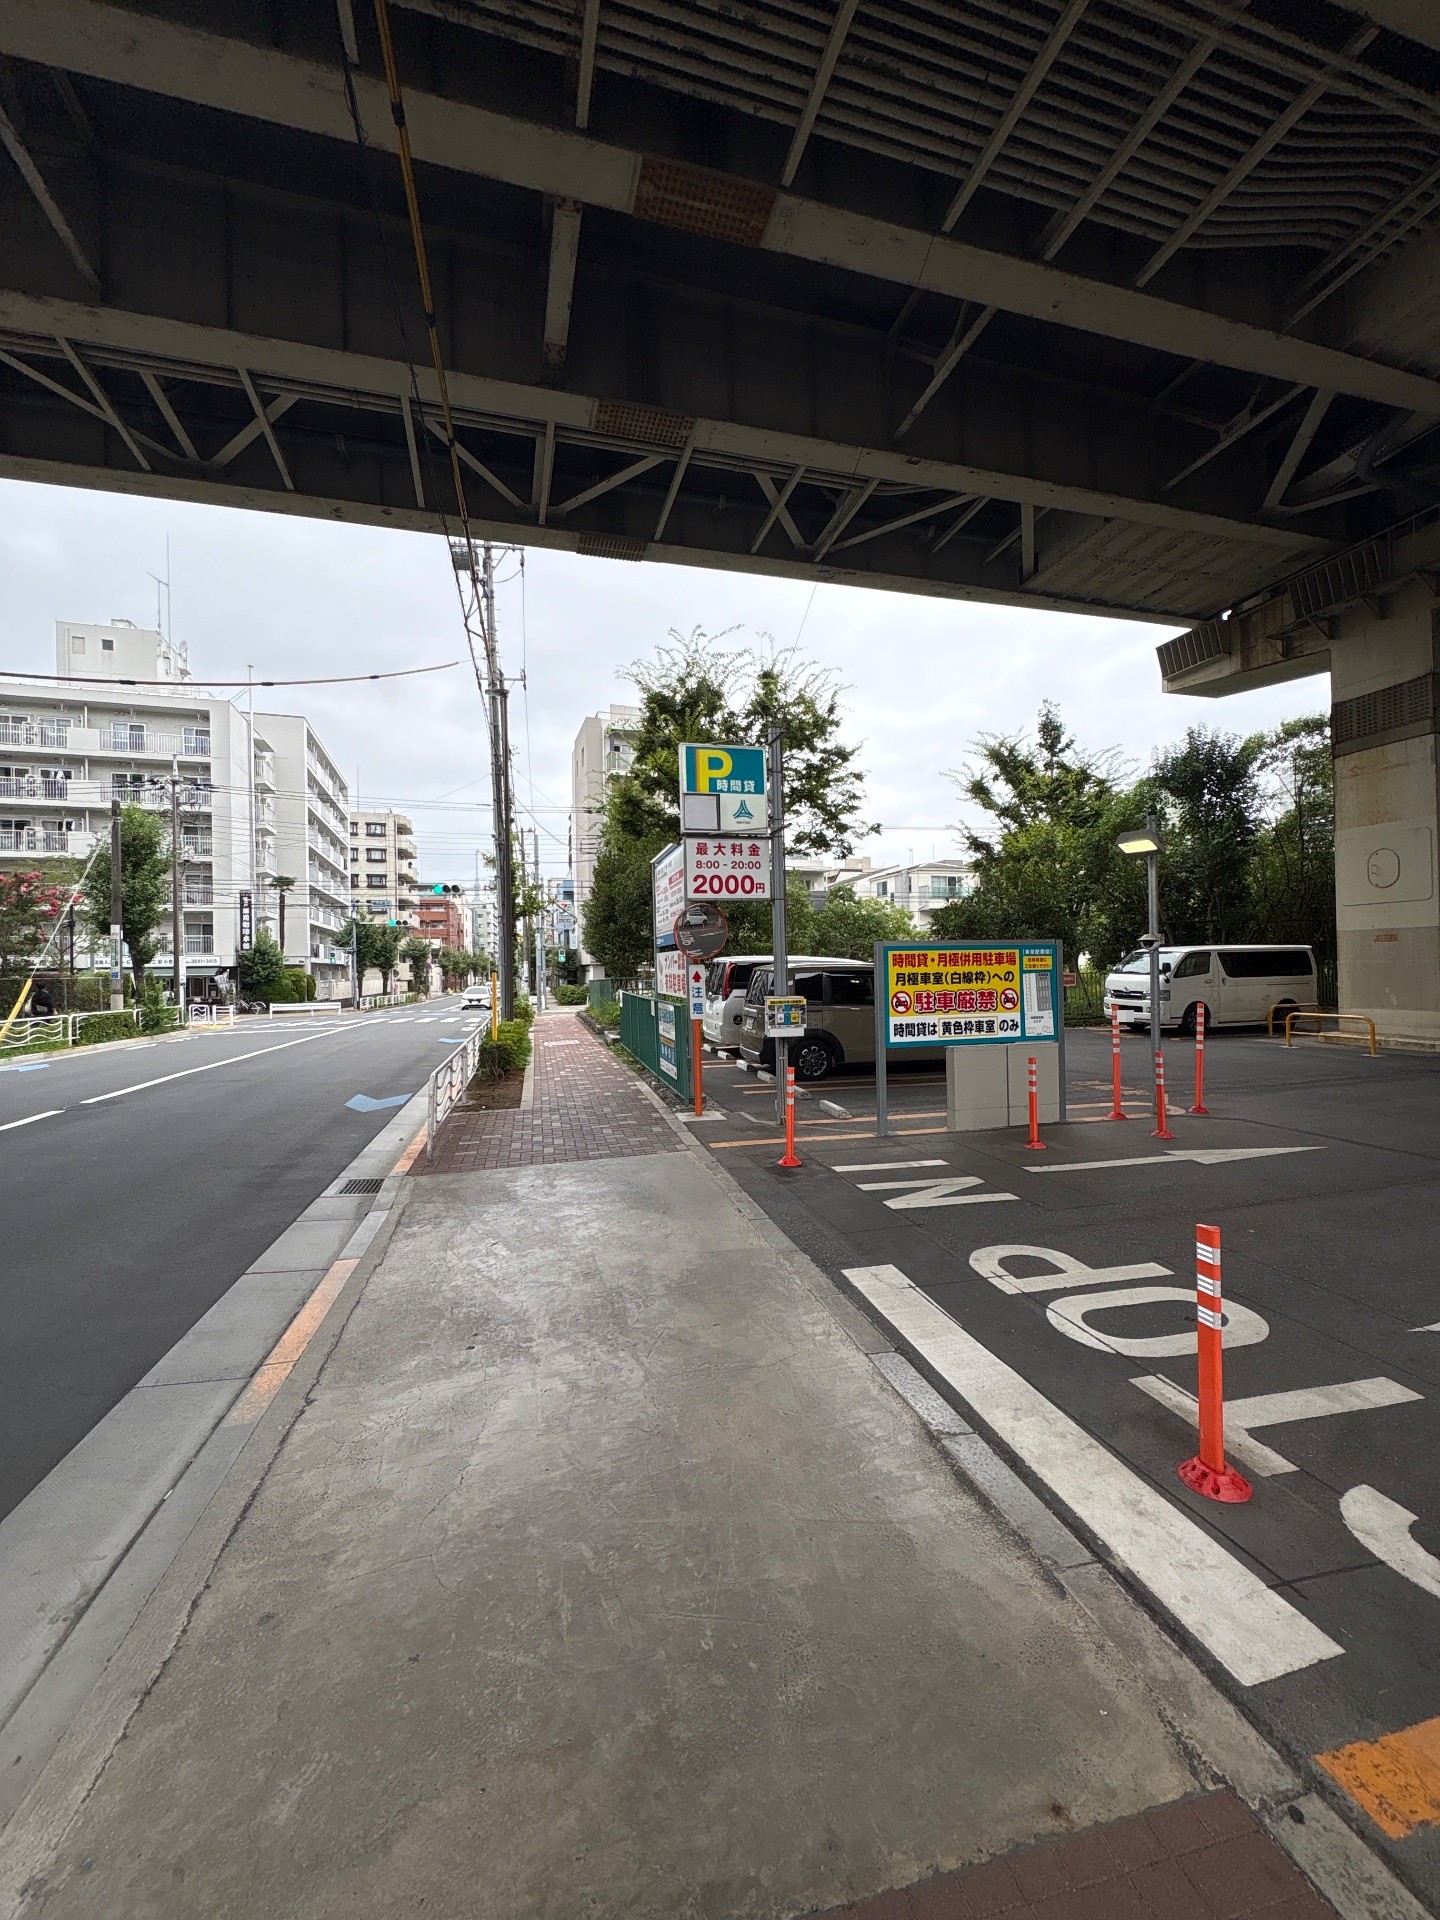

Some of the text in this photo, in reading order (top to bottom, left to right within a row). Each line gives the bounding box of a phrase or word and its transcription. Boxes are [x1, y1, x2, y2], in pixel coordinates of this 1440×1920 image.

[696, 748, 733, 793] P
[716, 780, 756, 792] 時間貸
[695, 842, 761, 856] 最大料金
[695, 860, 720, 869] 8:00
[730, 860, 762, 870] 20:00
[693, 874, 765, 894] 2000円
[892, 952, 1017, 968] 時間貸・月極併用駐車場
[692, 986, 704, 1014] 注意
[914, 989, 998, 1013] 駐車厳禁
[893, 1019, 1019, 1038] 時間貸は 黄色枠車室 のみ
